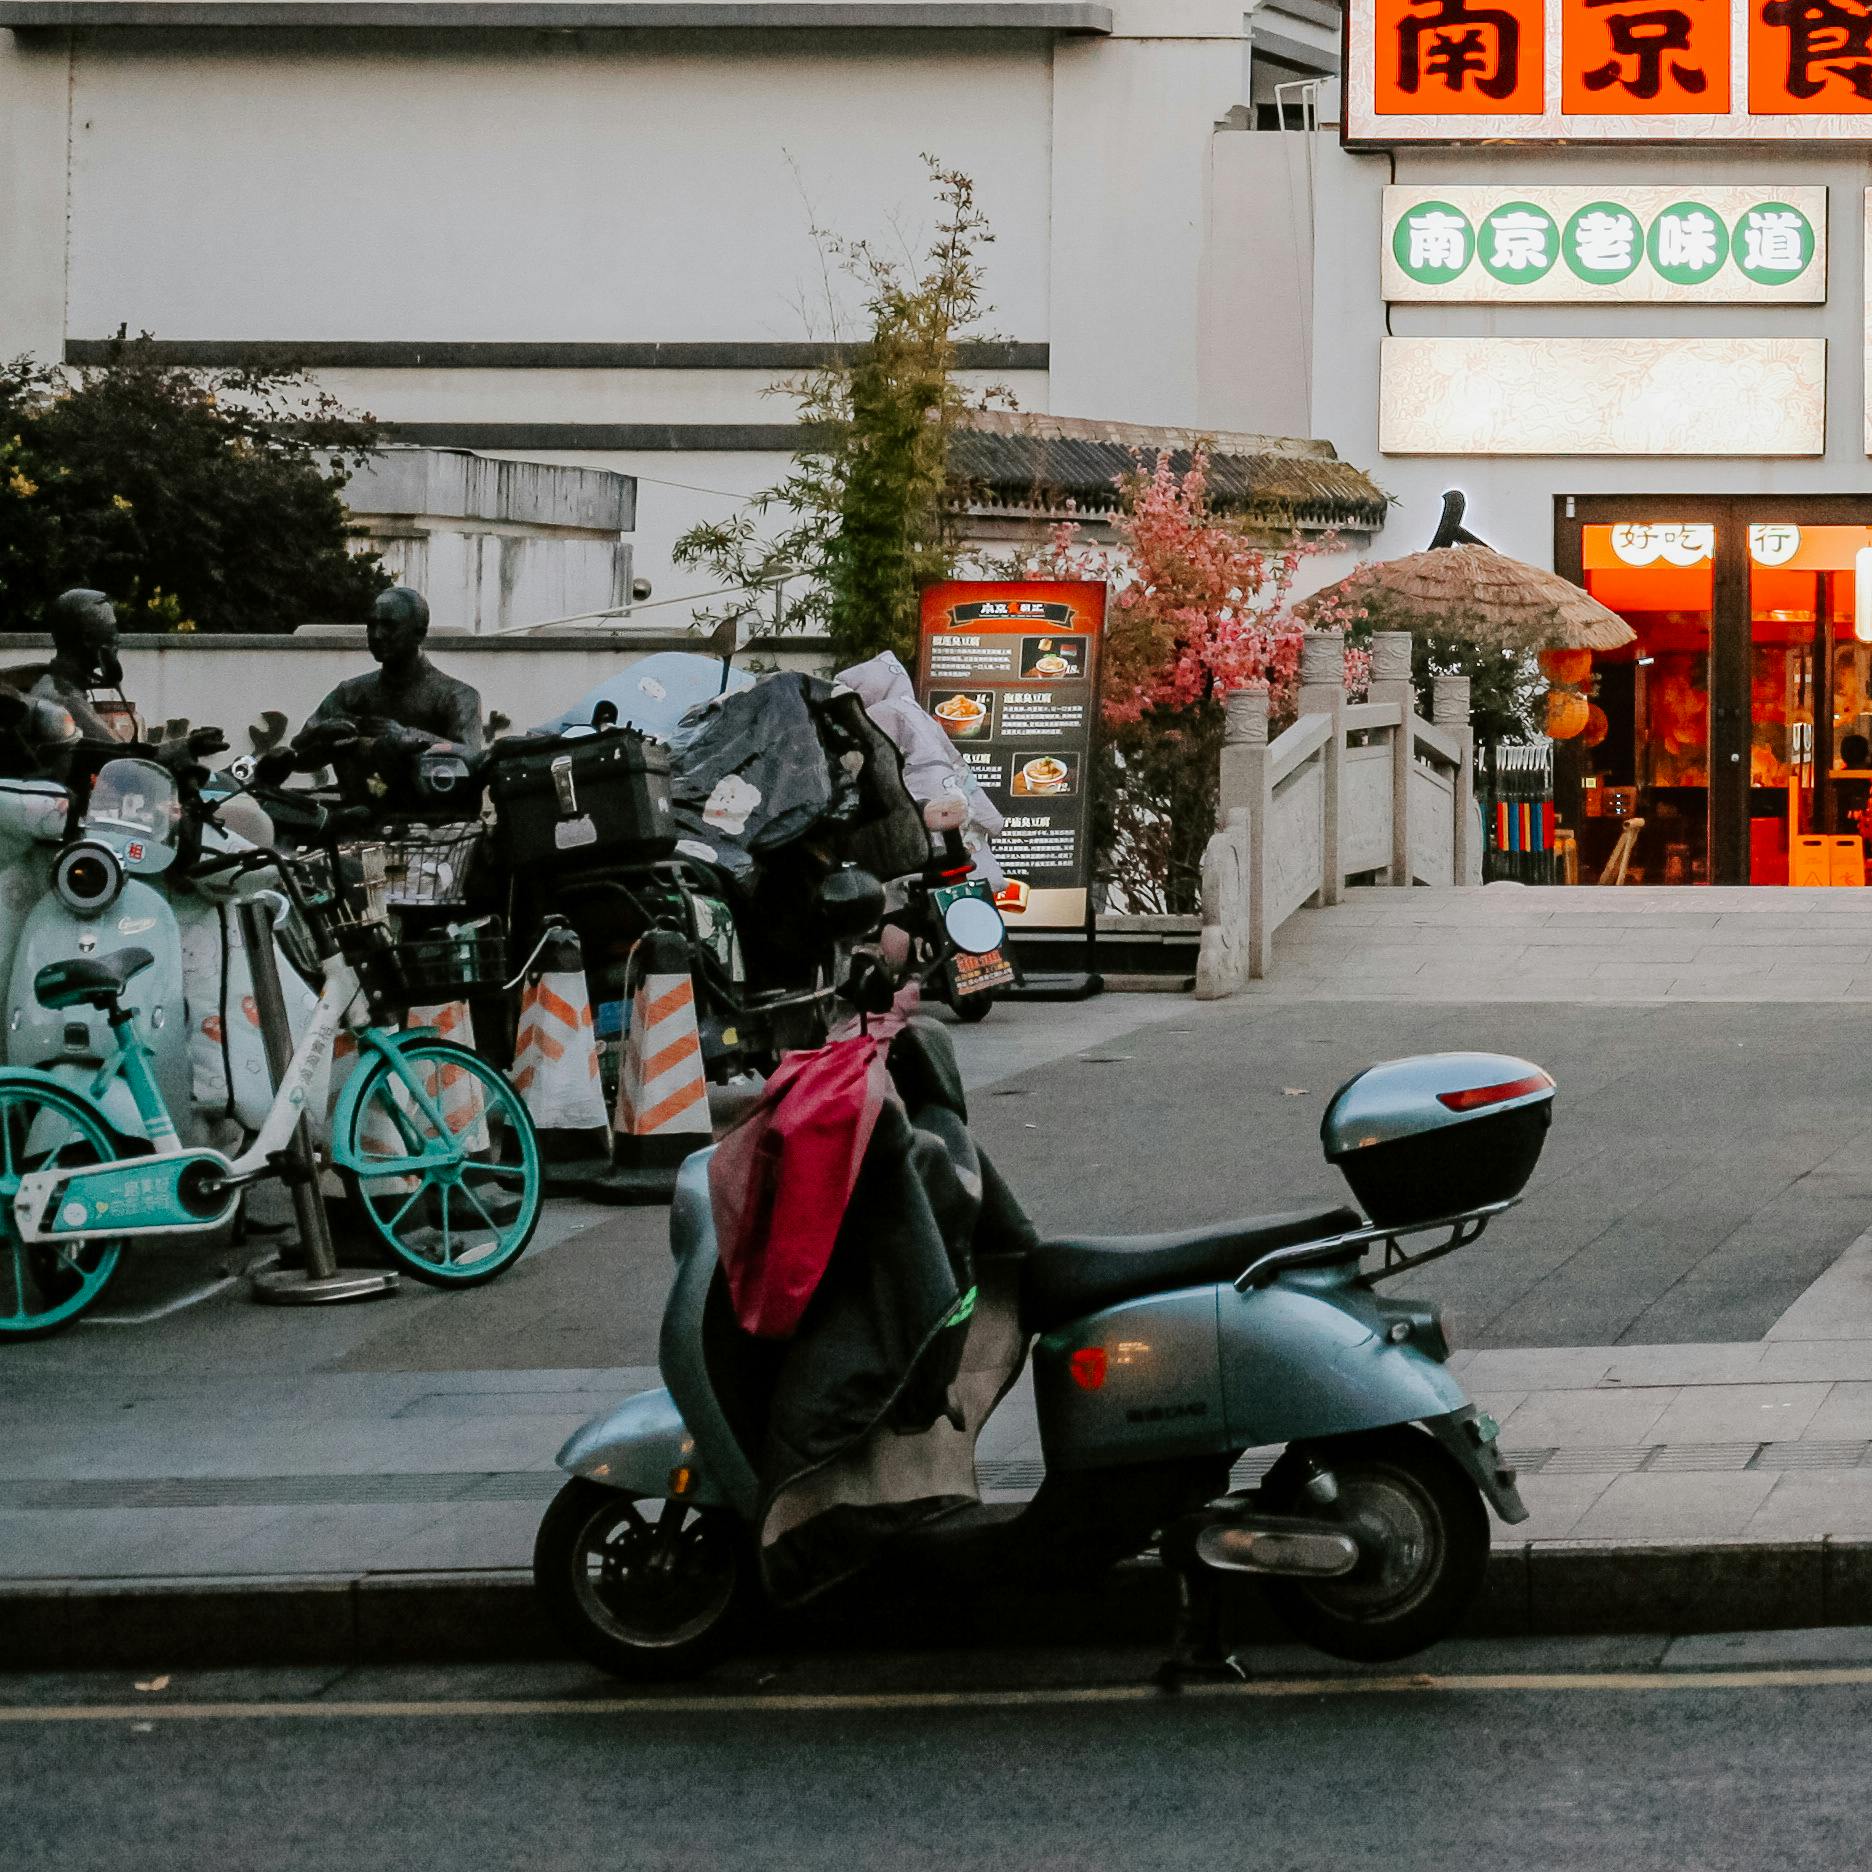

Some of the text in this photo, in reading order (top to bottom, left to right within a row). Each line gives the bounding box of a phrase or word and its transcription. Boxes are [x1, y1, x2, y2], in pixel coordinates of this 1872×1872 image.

[1408, 211, 1805, 272] 南京老味道
